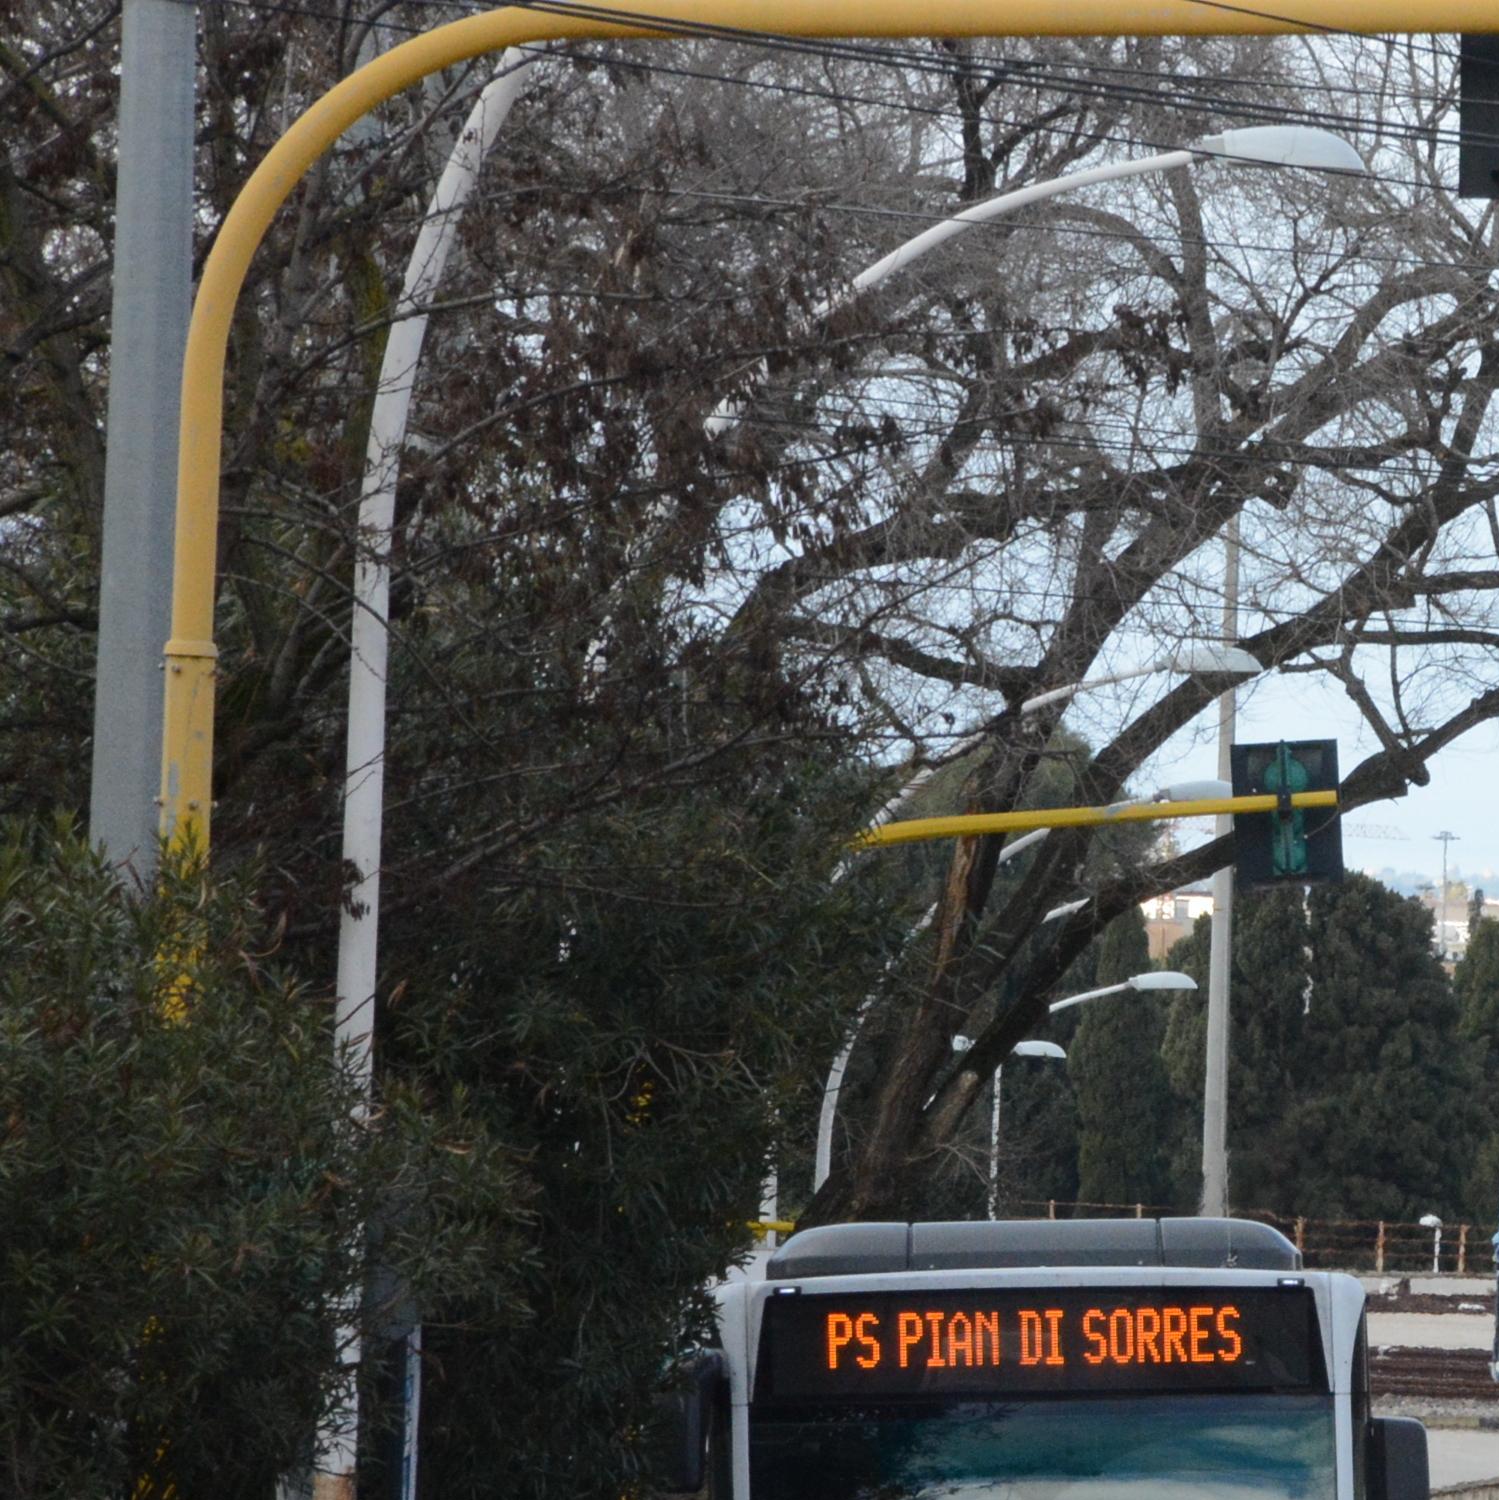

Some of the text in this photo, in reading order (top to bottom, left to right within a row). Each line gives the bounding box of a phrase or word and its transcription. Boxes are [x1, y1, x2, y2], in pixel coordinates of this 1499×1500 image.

[827, 1306, 1242, 1369] PS PIAN DI SORRES
